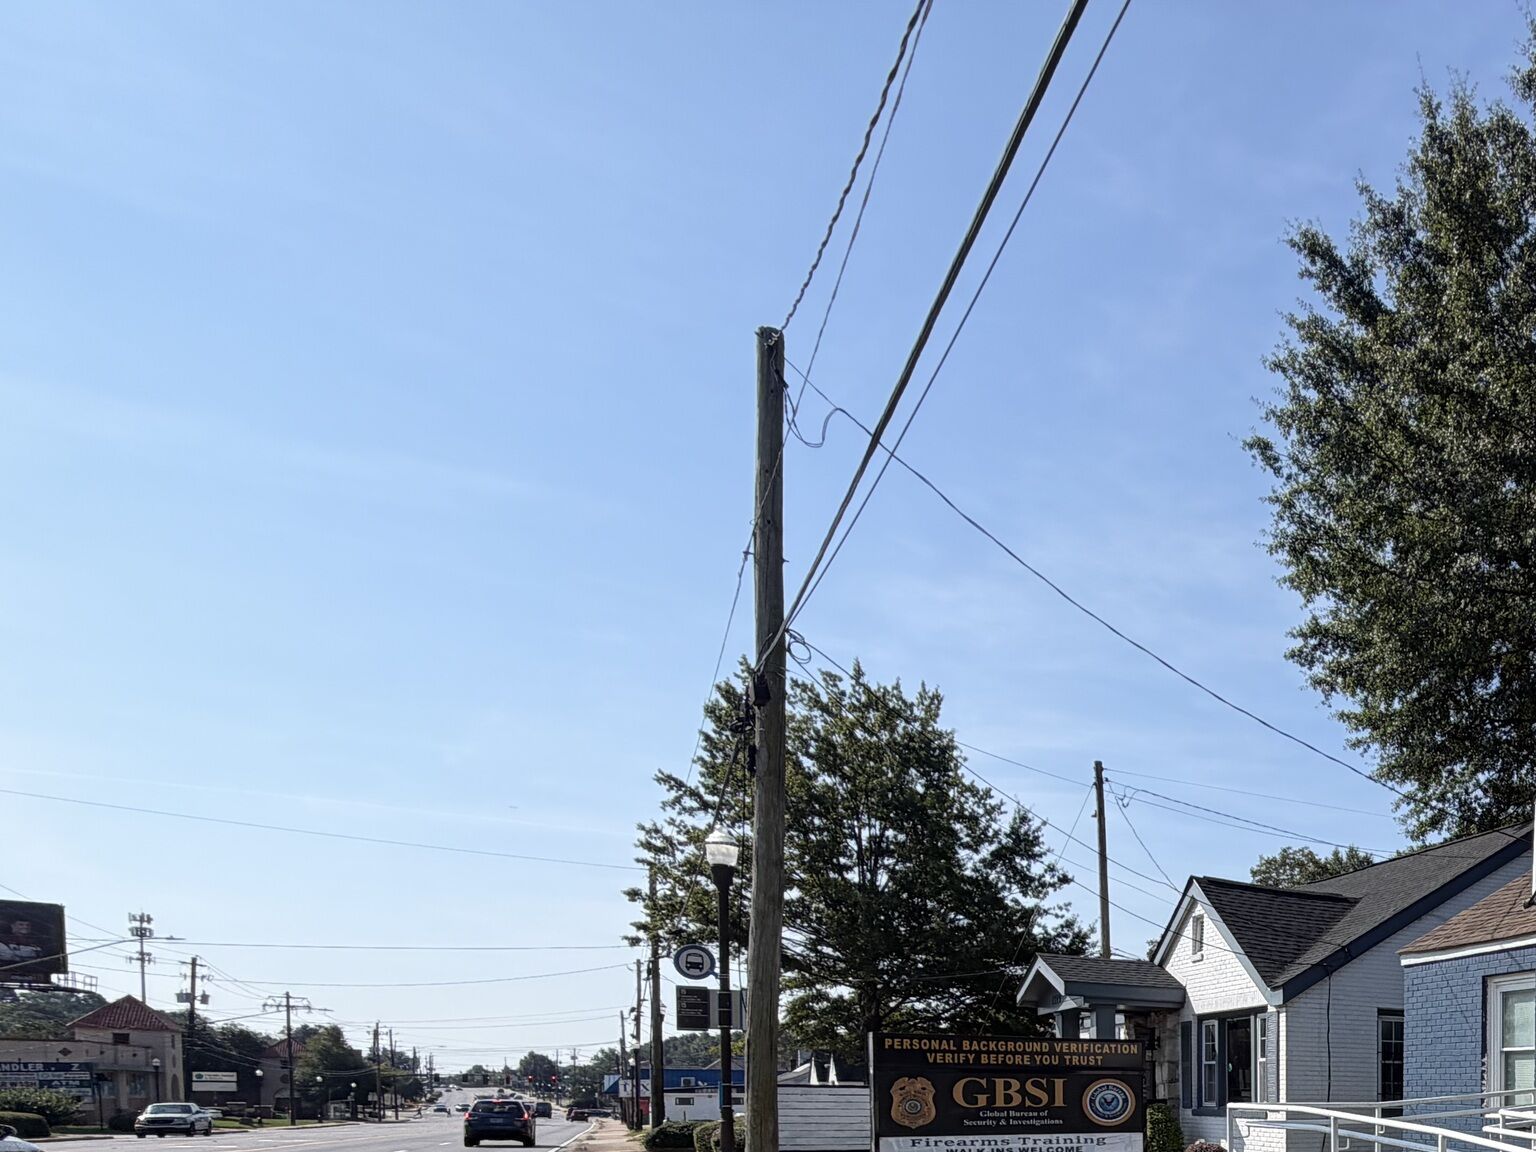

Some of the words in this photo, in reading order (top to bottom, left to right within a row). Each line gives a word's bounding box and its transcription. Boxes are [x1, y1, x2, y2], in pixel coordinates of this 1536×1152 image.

[884, 1038, 957, 1050] PERSONAL
[962, 1040, 1049, 1052] BACKGROUND
[1054, 1042, 1138, 1054] VERIFICATION
[926, 1053, 975, 1064] VERIFY
[981, 1053, 1031, 1065] BEFORE
[1035, 1054, 1059, 1065] YOU
[1064, 1055, 1103, 1066] TRUST
[0, 1063, 44, 1071] NDLER
[952, 1077, 1068, 1108] GBSI
[963, 1119, 997, 1127] Security
[1009, 1118, 1063, 1126] Investigations
[910, 1138, 1011, 1147] Firearms
[1018, 1136, 1108, 1146] Training
